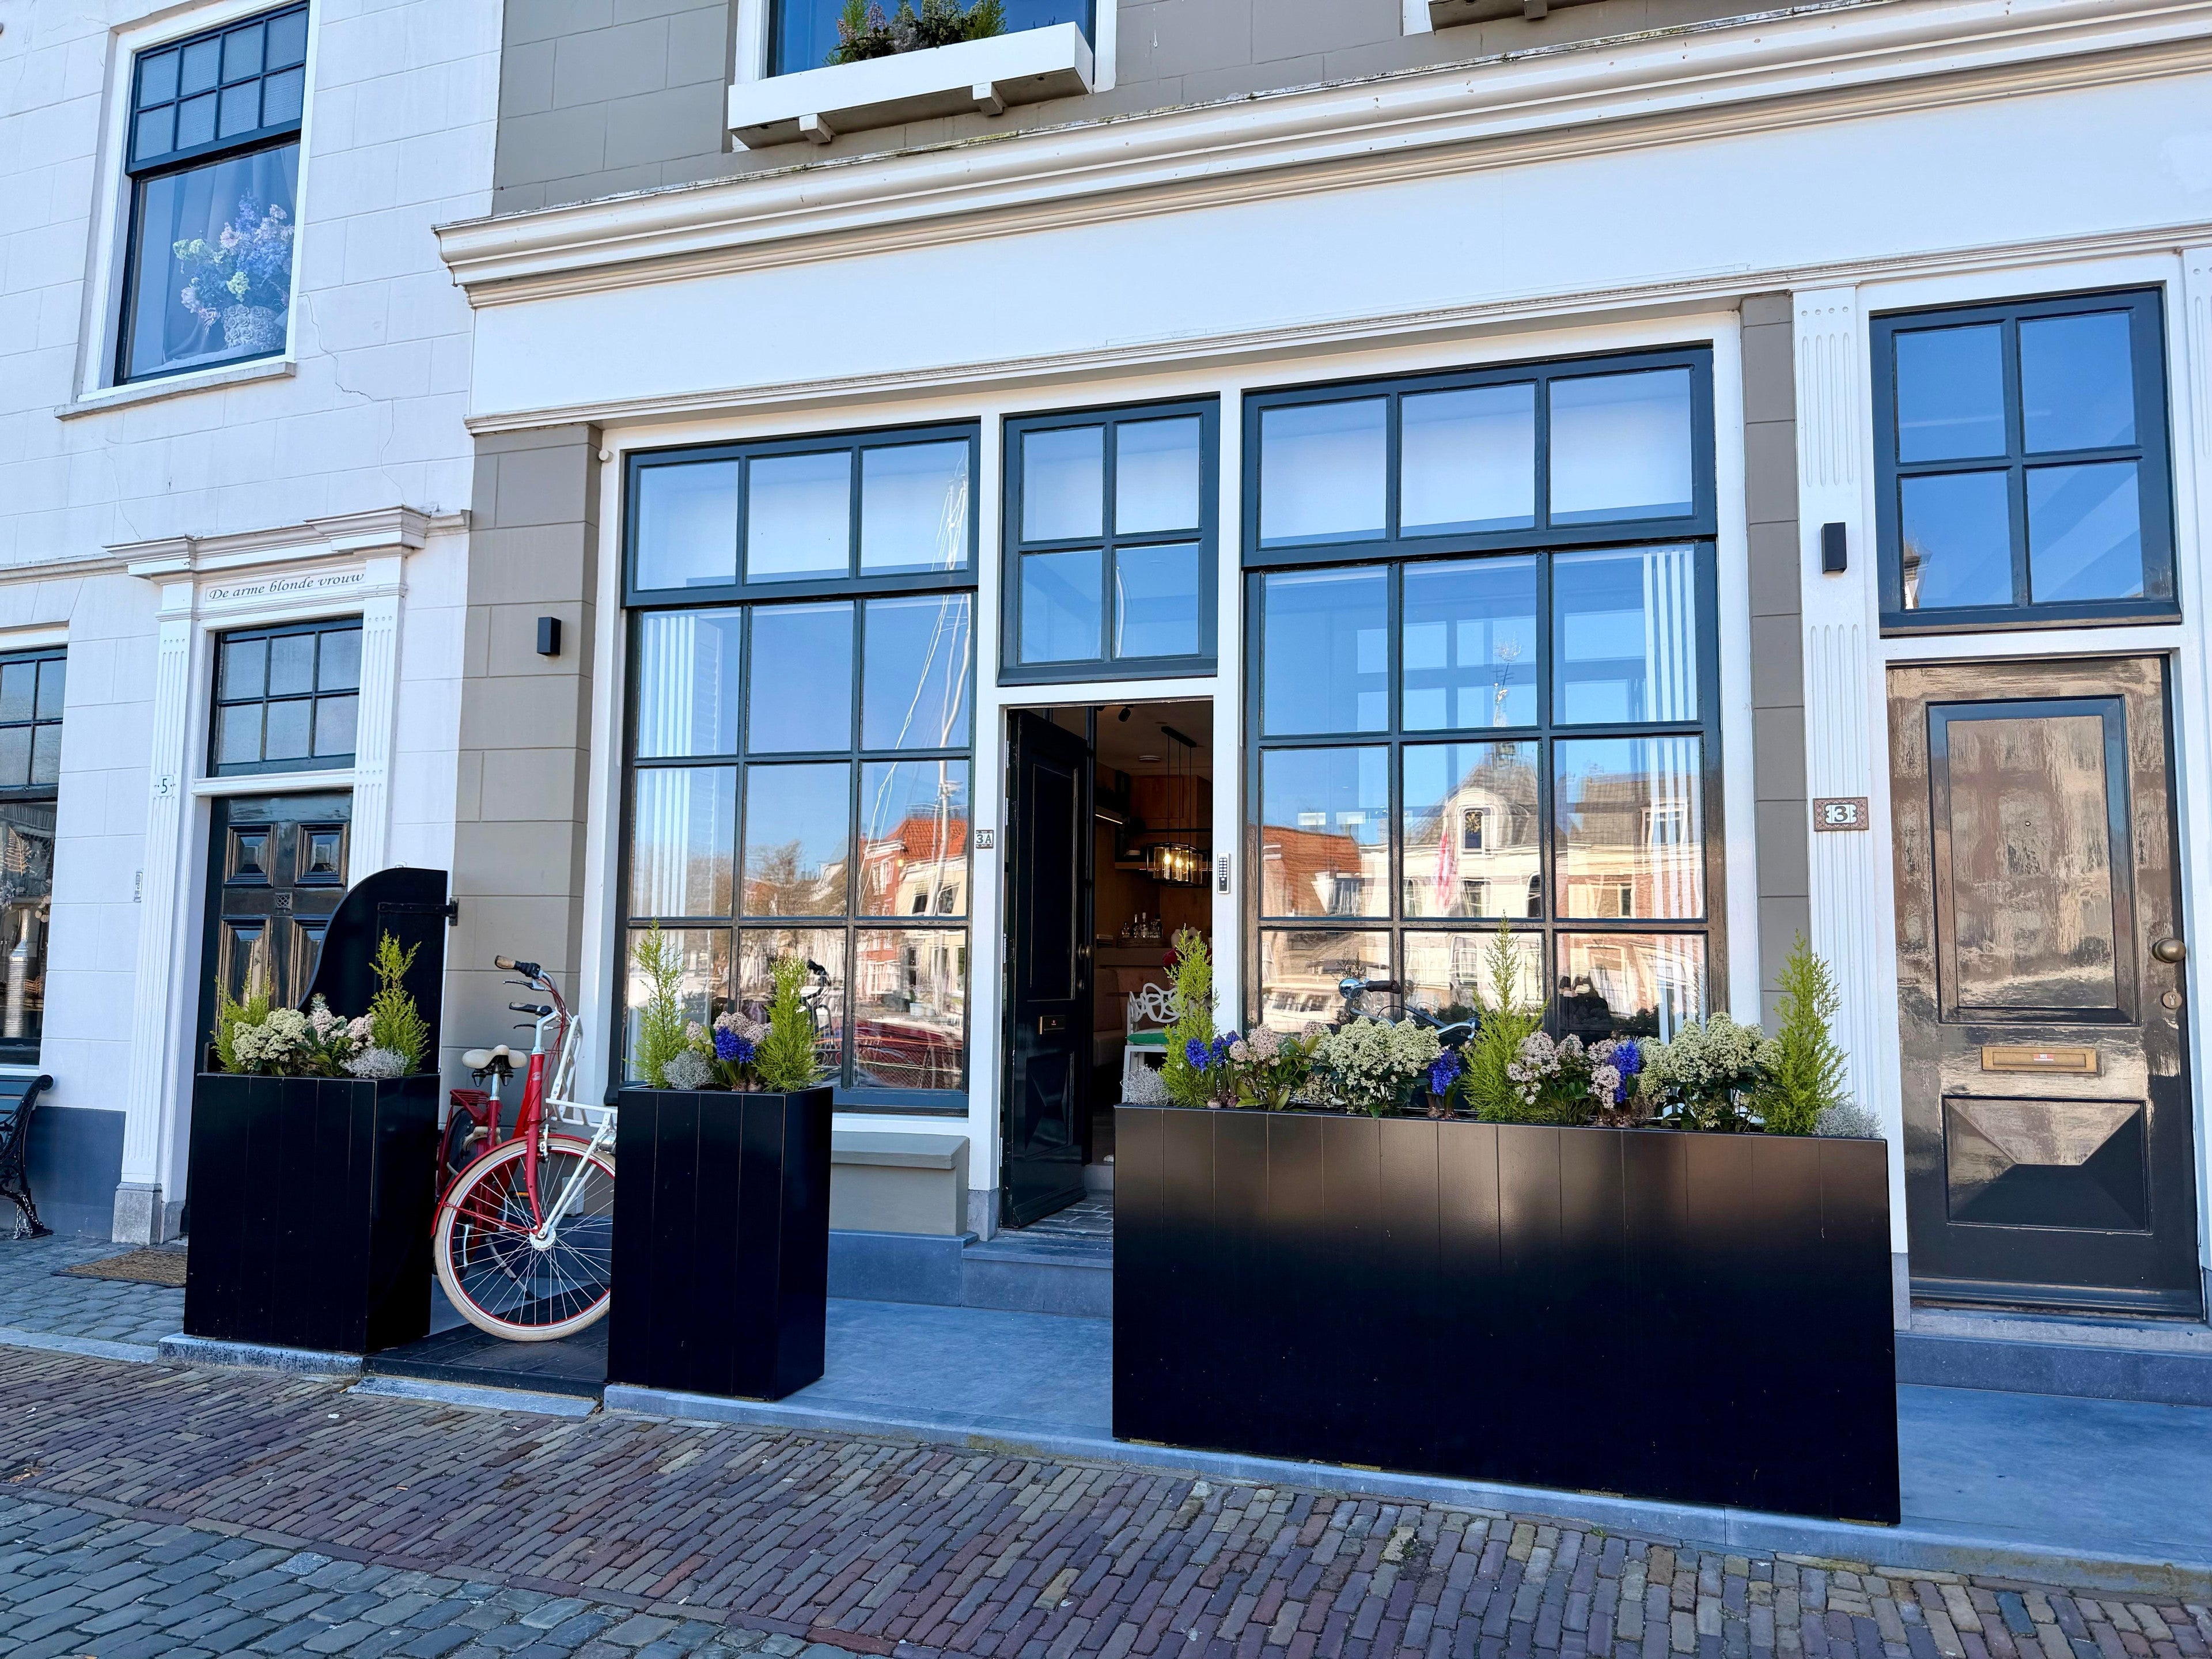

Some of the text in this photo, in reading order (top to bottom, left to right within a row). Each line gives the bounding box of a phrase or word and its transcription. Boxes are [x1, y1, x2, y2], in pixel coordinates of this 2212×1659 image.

[209, 574, 364, 599] De arme blonde vrouw
[161, 778, 167, 793] 5
[1834, 805, 1848, 822] 3
[976, 834, 991, 844] 3A
